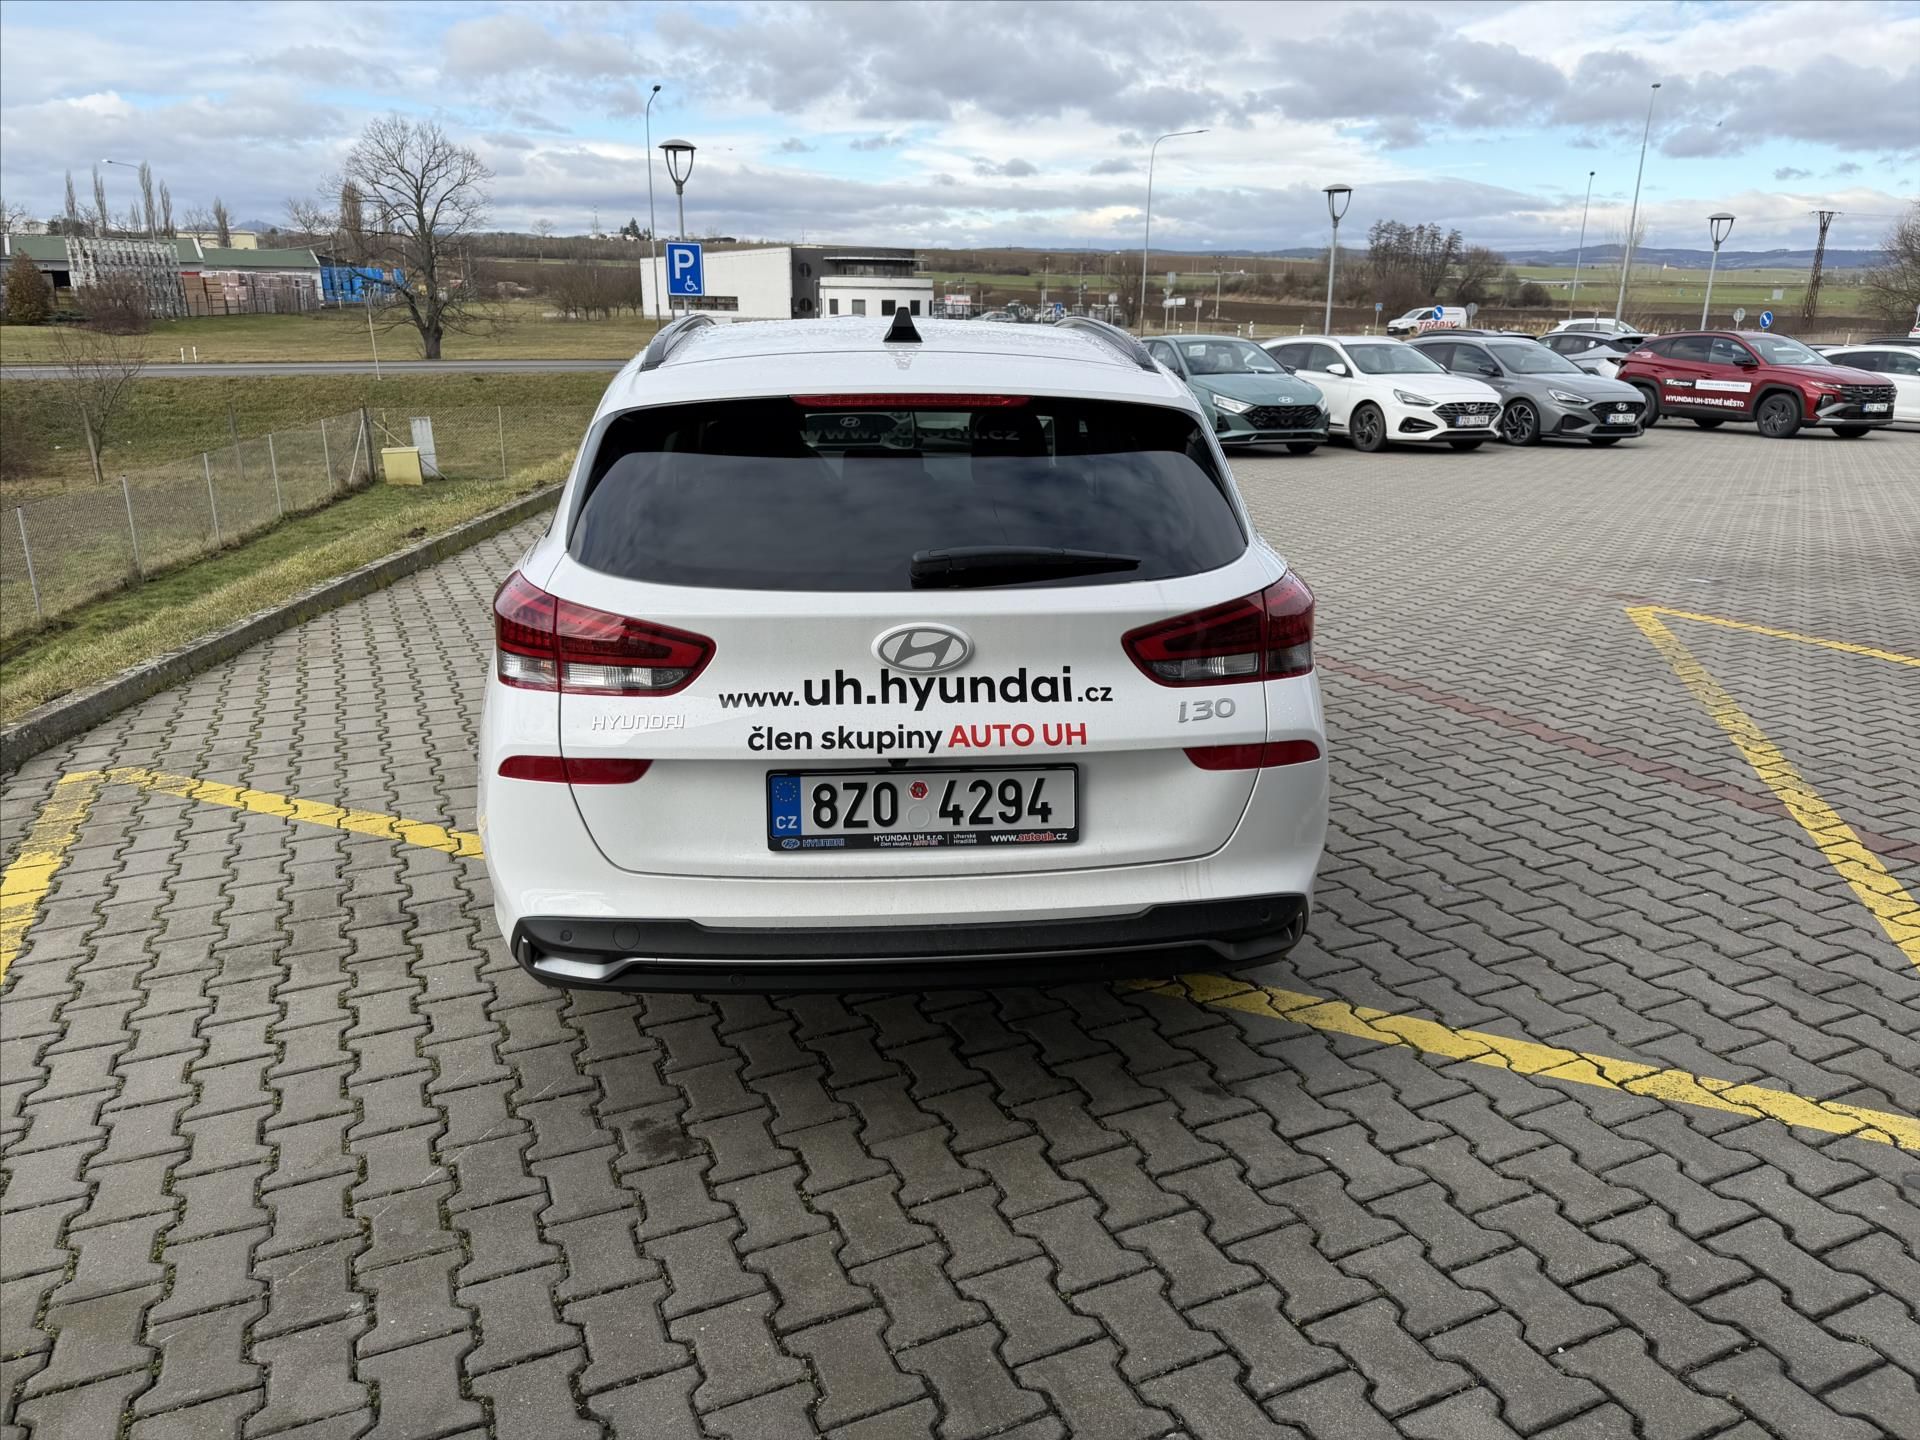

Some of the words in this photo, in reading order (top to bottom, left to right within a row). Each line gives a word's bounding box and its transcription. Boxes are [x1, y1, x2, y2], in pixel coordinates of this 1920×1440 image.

[674, 249, 694, 279] P
[1665, 394, 1694, 404] HYUNDAI
[718, 666, 1113, 711] www.uh.hyundai.cz
[592, 714, 686, 731] HYUNDAI
[747, 725, 813, 751] člen
[820, 723, 943, 754] skupiny
[948, 723, 1035, 748] AUTO
[1042, 723, 1087, 746] UH
[938, 777, 1052, 826] 4294
[776, 815, 798, 829] CZ
[802, 838, 845, 847] HYUNDAI
[873, 834, 911, 842] HYUNDAI
[990, 832, 1068, 842] www.autouh.cz
